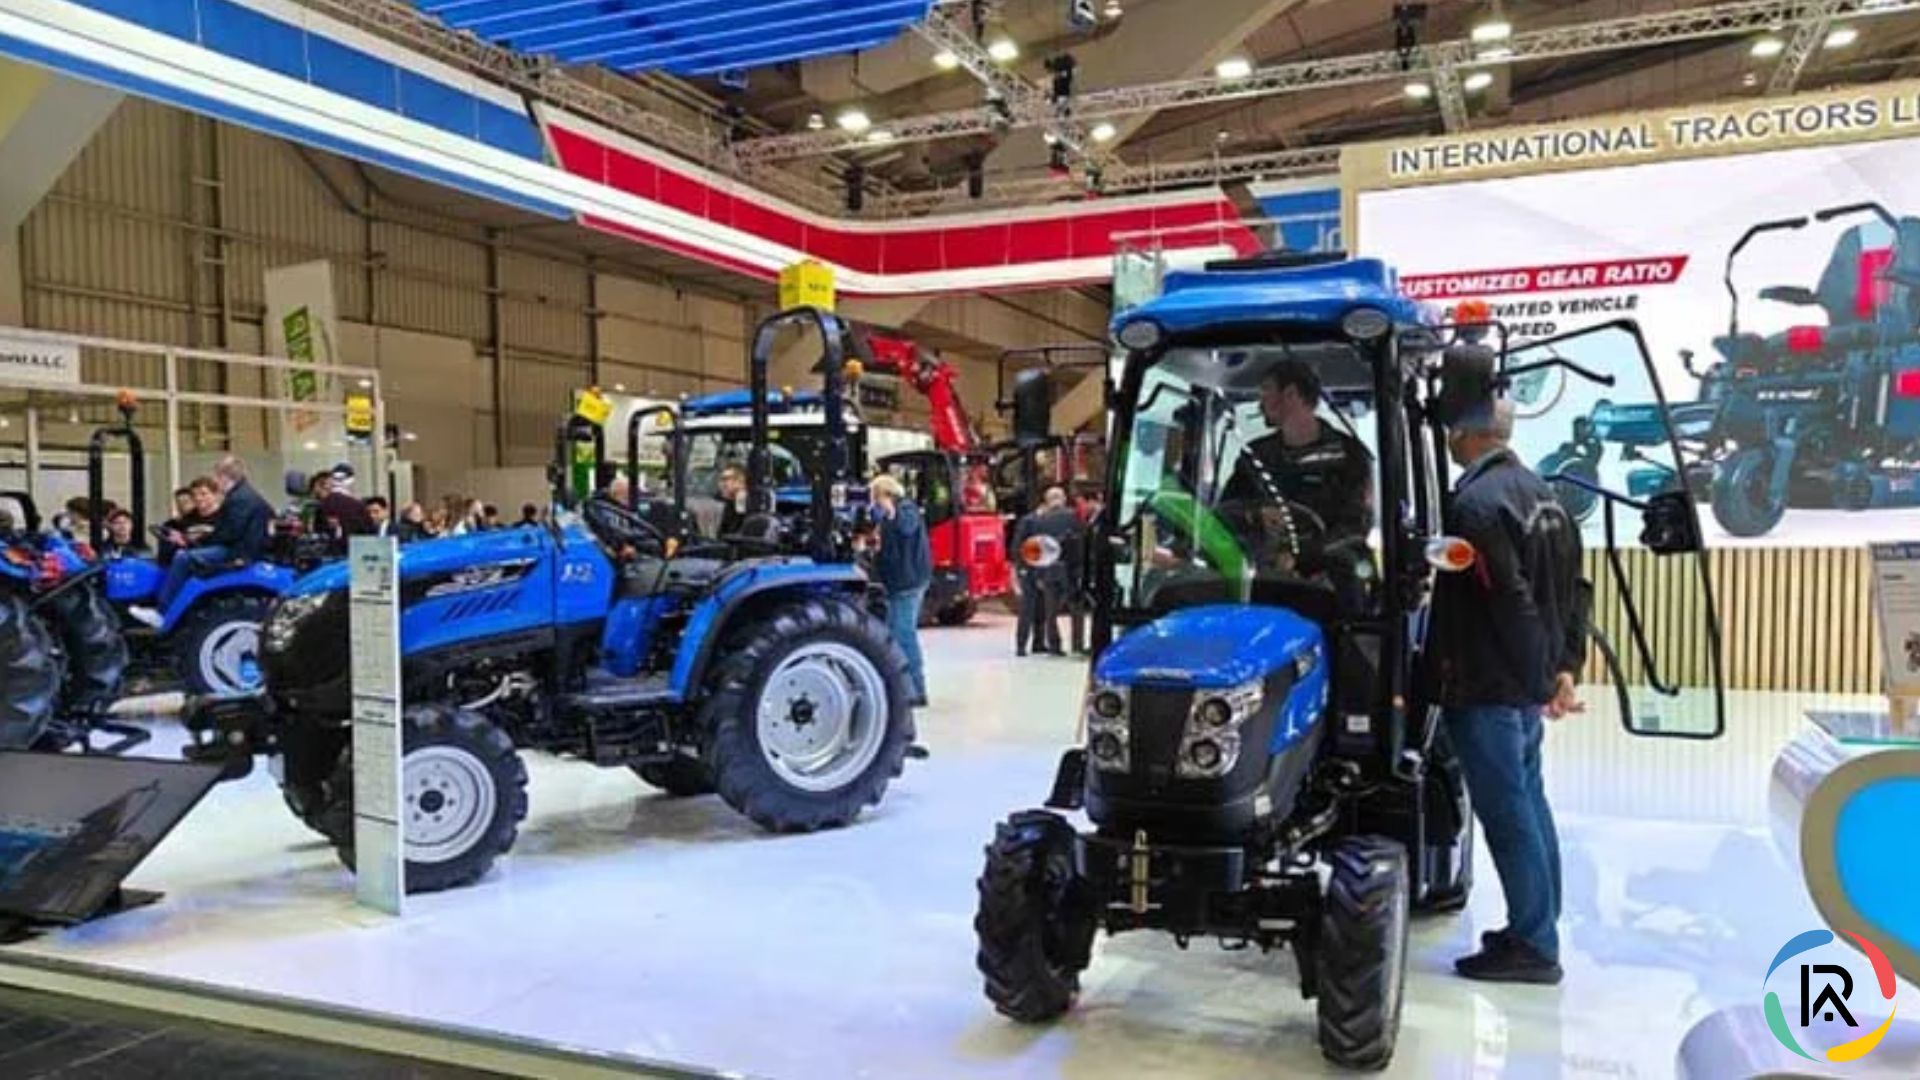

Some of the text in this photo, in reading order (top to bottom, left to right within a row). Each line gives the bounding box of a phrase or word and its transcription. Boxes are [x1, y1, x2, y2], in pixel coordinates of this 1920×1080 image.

[1391, 124, 1656, 173] INTERNATIONAL
[1671, 99, 1878, 144] TRACTORS
[1537, 266, 1598, 288] GEAR
[1603, 261, 1672, 284] RATIO
[1558, 294, 1639, 314] VEHICLE
[1507, 321, 1557, 337] PEED
